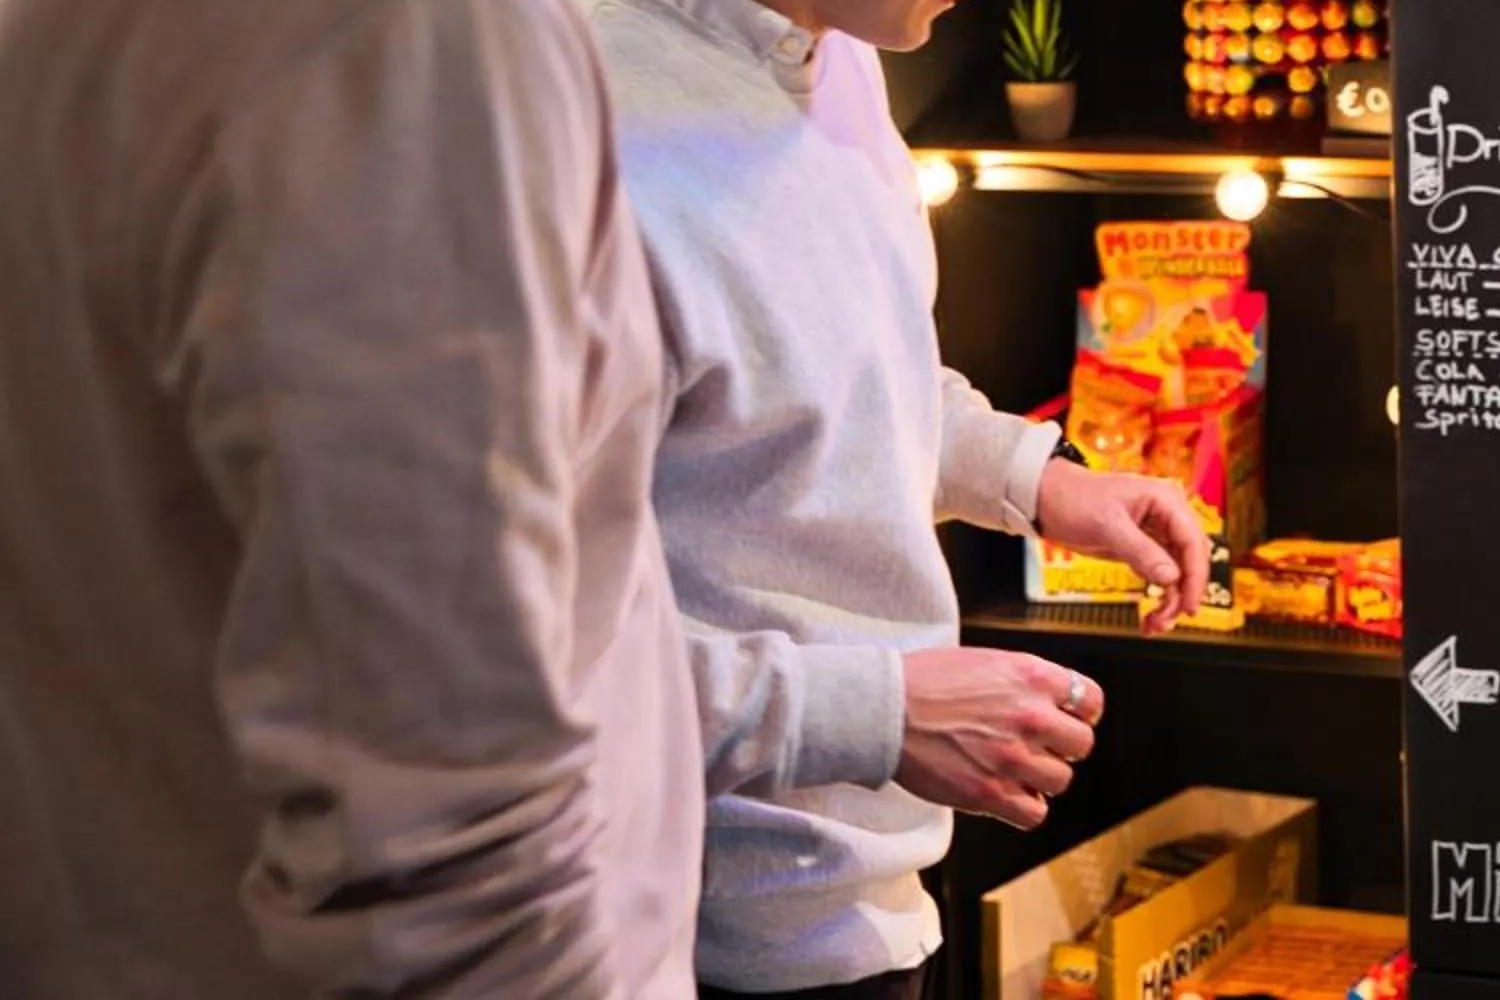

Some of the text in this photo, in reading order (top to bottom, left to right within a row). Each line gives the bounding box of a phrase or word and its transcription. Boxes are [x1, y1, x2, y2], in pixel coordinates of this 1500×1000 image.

[1411, 242, 1477, 269] VIVA
[1416, 268, 1474, 293] LAUT
[1414, 295, 1482, 321] LEISE
[1415, 359, 1486, 383] COLA
